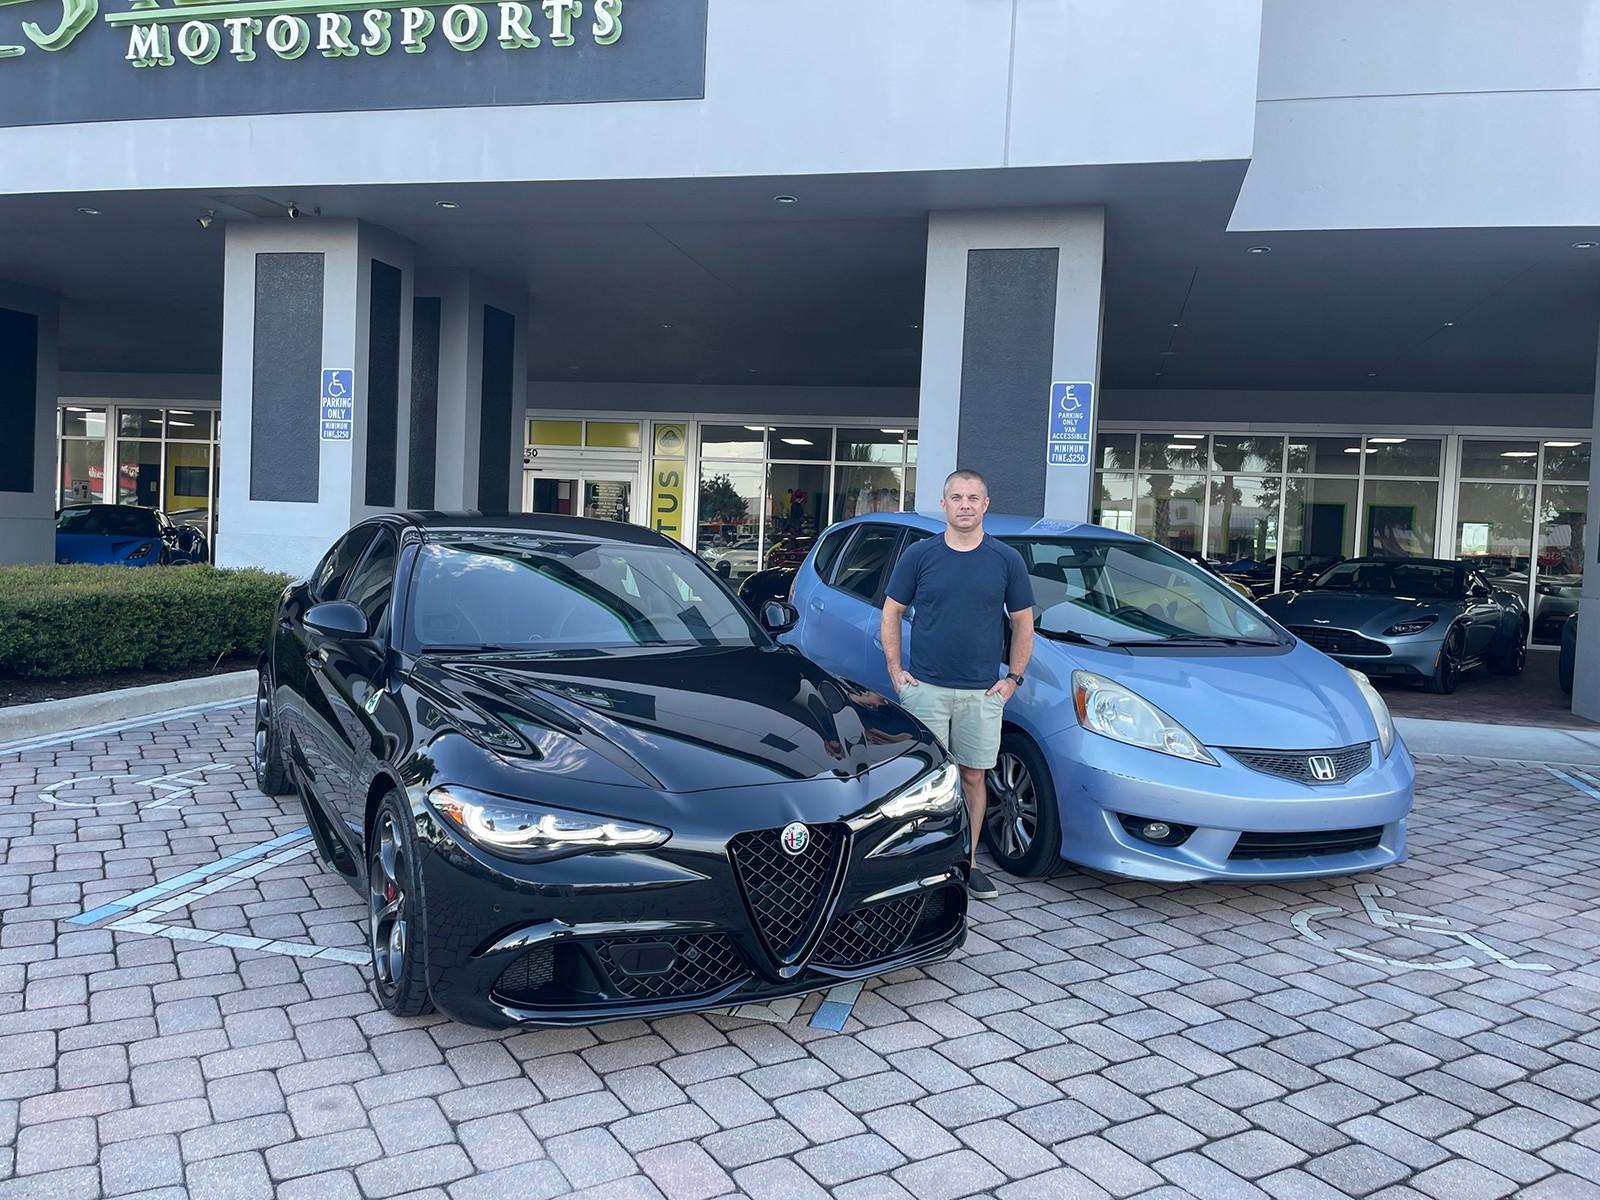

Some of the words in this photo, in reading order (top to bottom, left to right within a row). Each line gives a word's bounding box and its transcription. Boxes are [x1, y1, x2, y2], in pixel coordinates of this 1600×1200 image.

[125, 0, 622, 67] MOTORSPORTS
[322, 397, 352, 408] PARKING
[327, 408, 346, 419] ONLY
[325, 422, 348, 430] MINIMUM
[1054, 444, 1084, 453] MINIMUM
